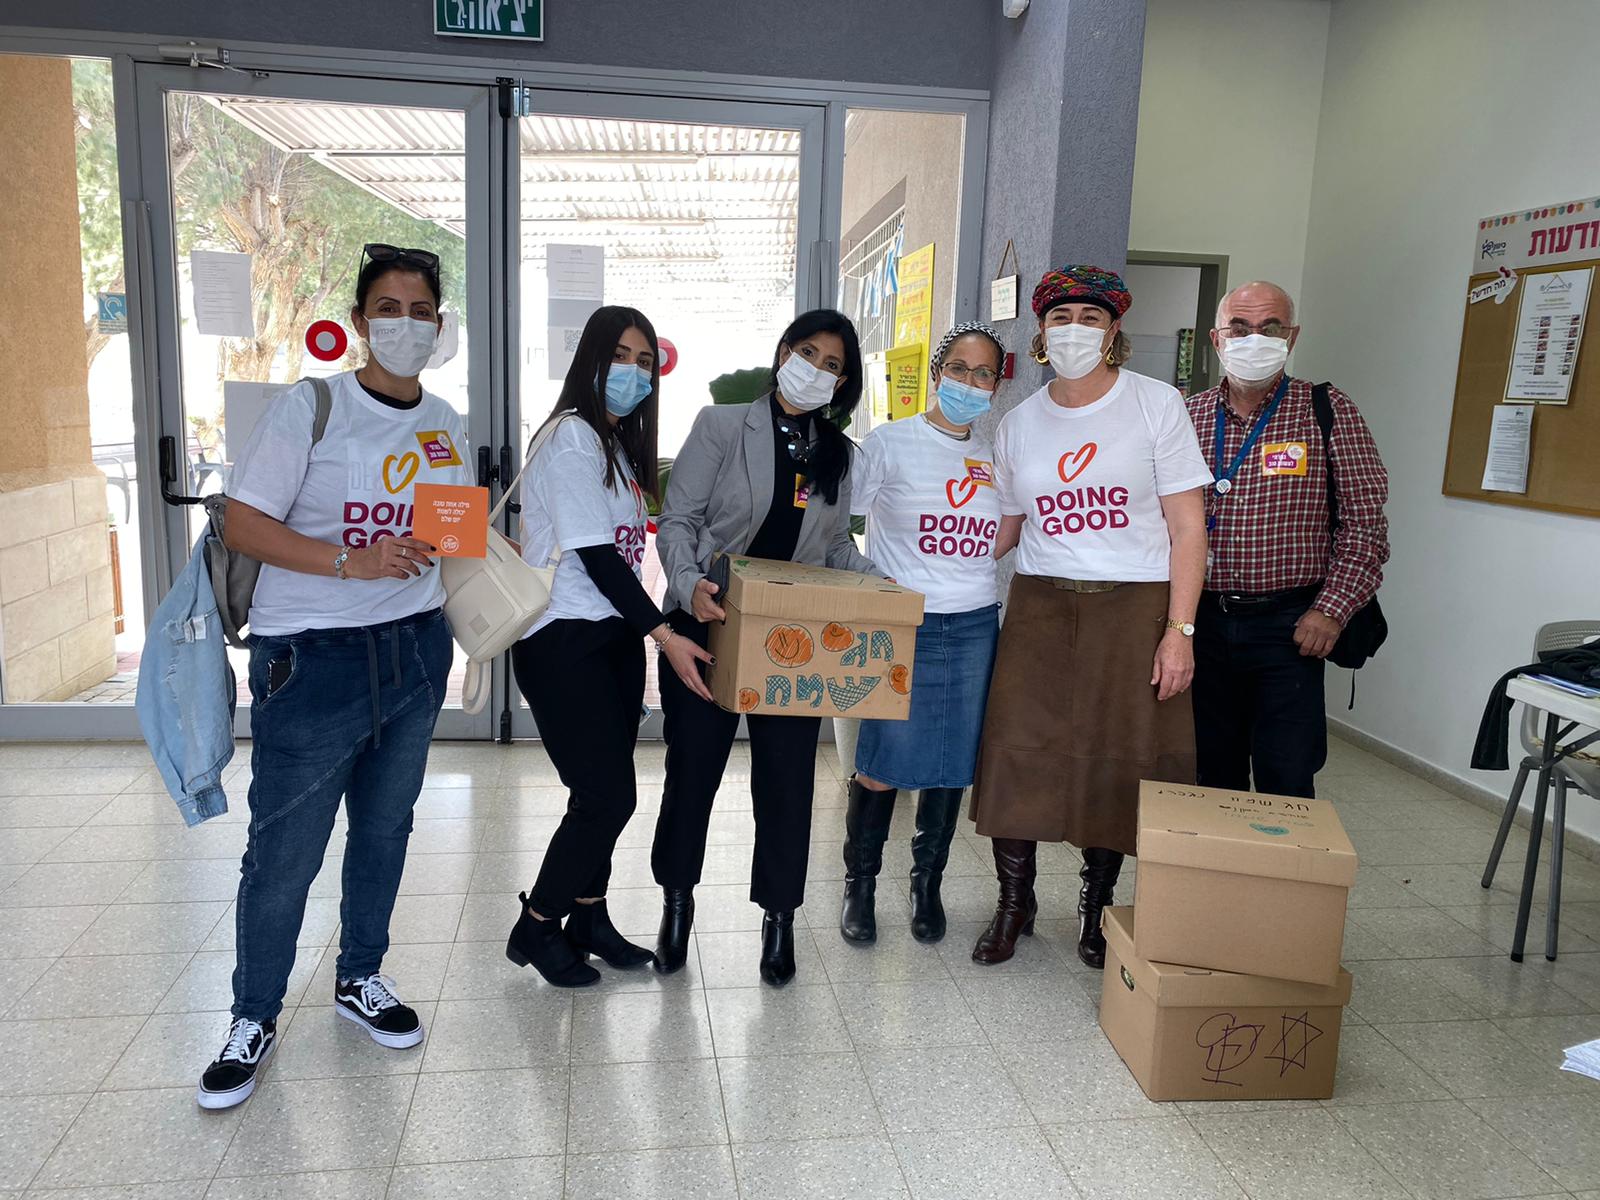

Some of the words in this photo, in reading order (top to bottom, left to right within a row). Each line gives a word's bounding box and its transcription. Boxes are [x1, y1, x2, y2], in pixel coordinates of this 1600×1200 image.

[1527, 220, 1600, 257] ודעות
[1471, 286, 1492, 300] חדש?
[1494, 279, 1506, 290] מה
[343, 502, 414, 527] DOI
[1035, 486, 1129, 516] DOING
[919, 514, 997, 540] DOING
[1042, 509, 1130, 537] GOOD
[918, 534, 989, 558] GOOD
[840, 630, 894, 668] חג
[765, 673, 881, 712] שמח
